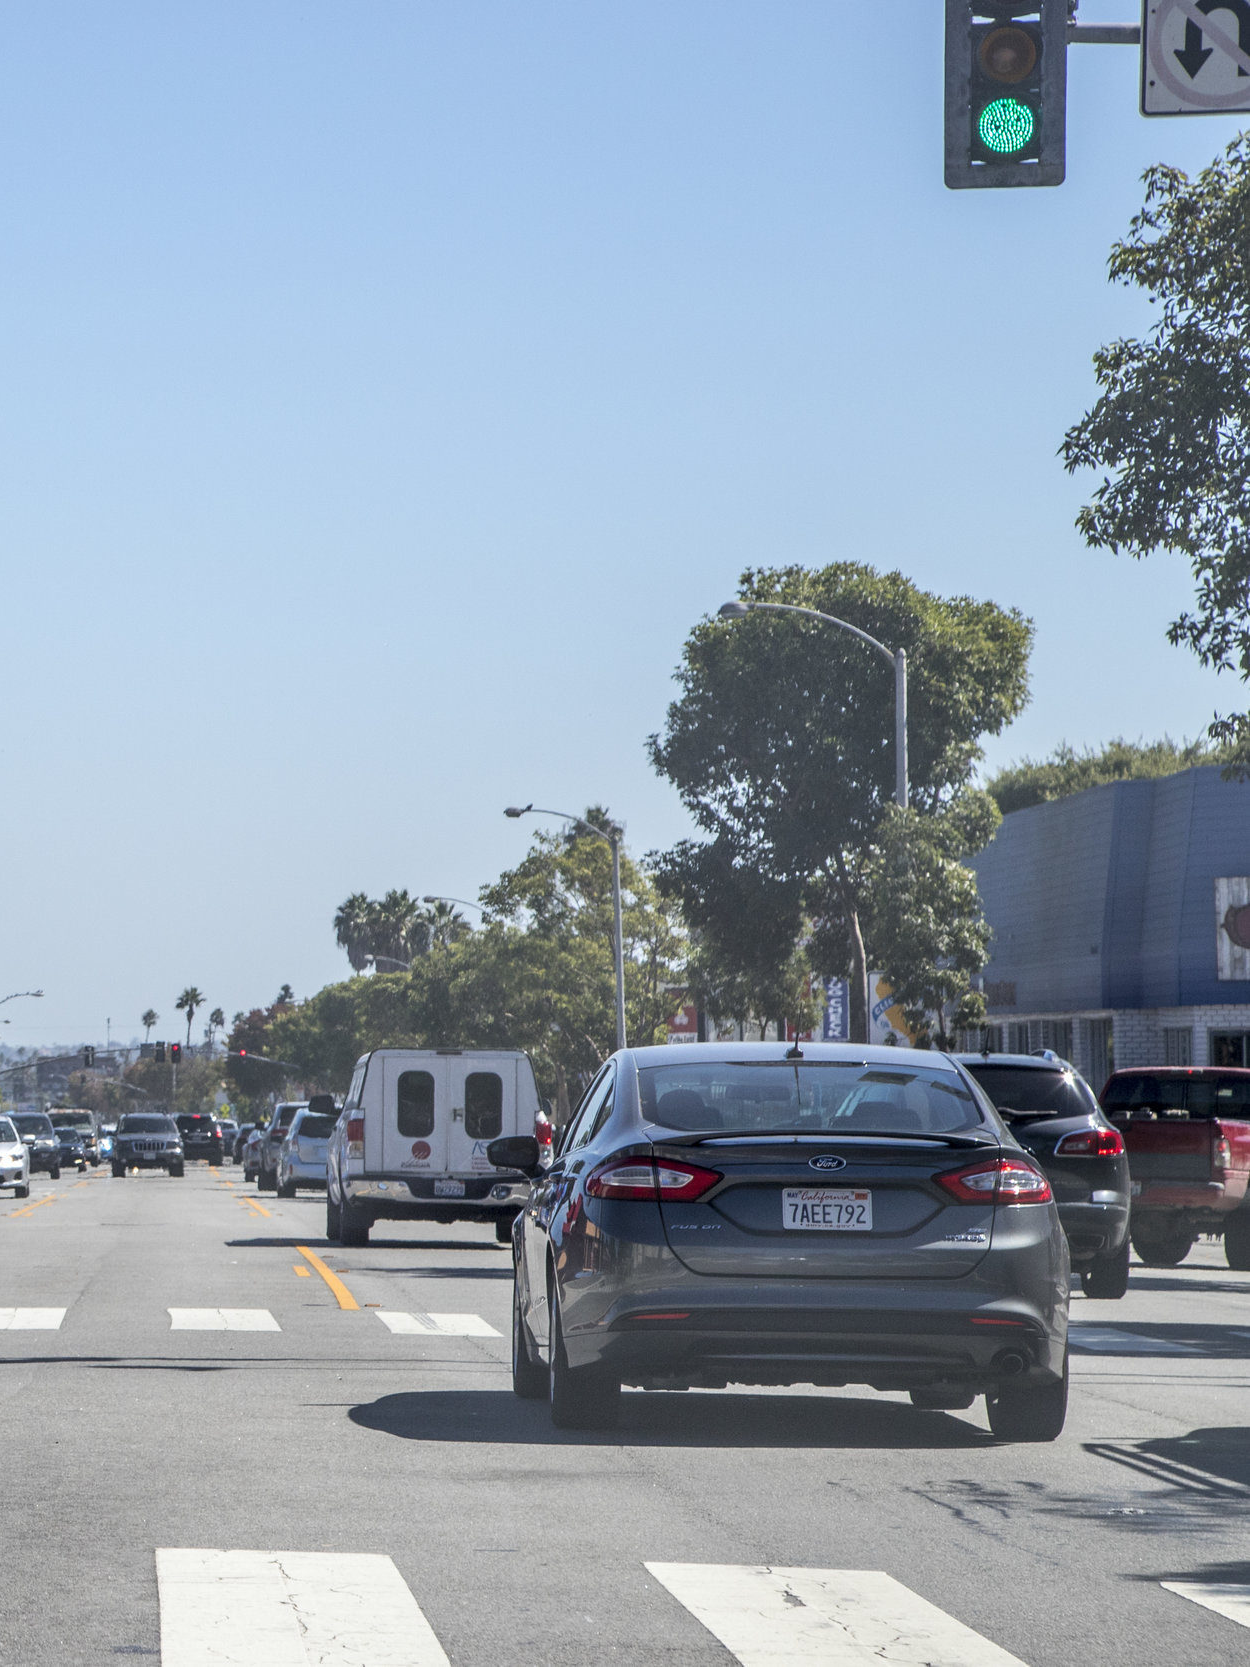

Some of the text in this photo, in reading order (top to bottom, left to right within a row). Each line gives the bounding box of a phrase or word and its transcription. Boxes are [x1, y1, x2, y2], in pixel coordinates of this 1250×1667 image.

[816, 1158, 839, 1168] Ford
[800, 1191, 853, 1203] California
[788, 1203, 867, 1224] 7AEE792
